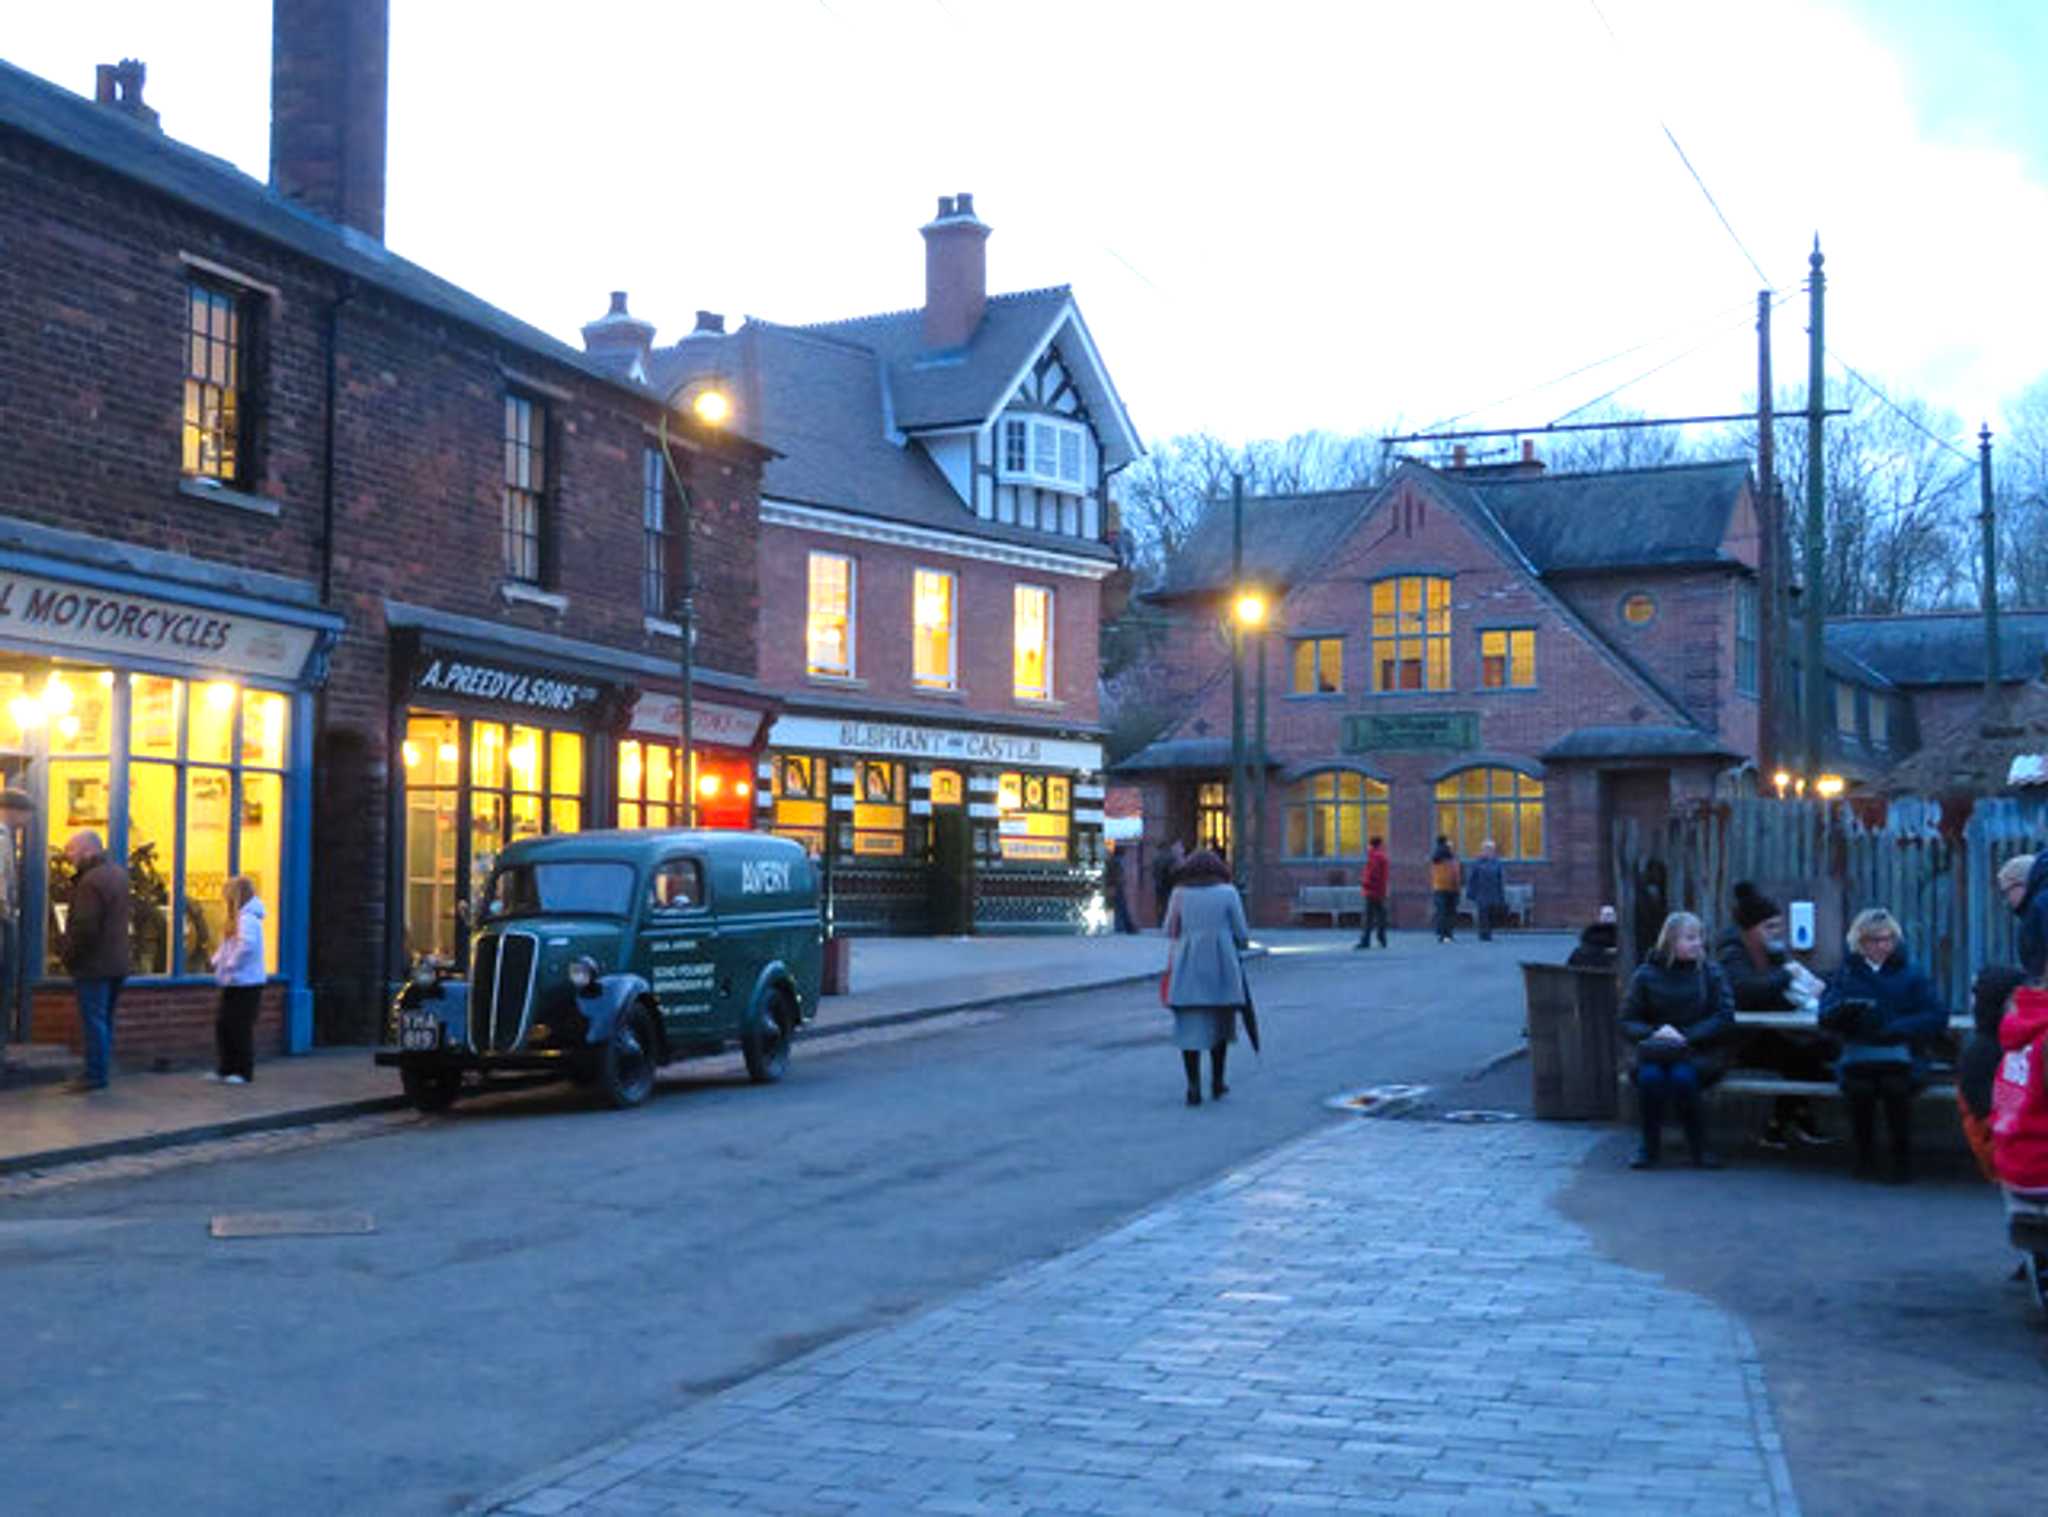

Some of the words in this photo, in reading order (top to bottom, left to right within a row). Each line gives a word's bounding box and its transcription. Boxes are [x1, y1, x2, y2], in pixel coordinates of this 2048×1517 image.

[22, 588, 232, 651] MOTORCYCLES
[838, 722, 945, 753] ELEPHANT
[965, 734, 1042, 760] CASTLE
[741, 860, 791, 895] AVERY
